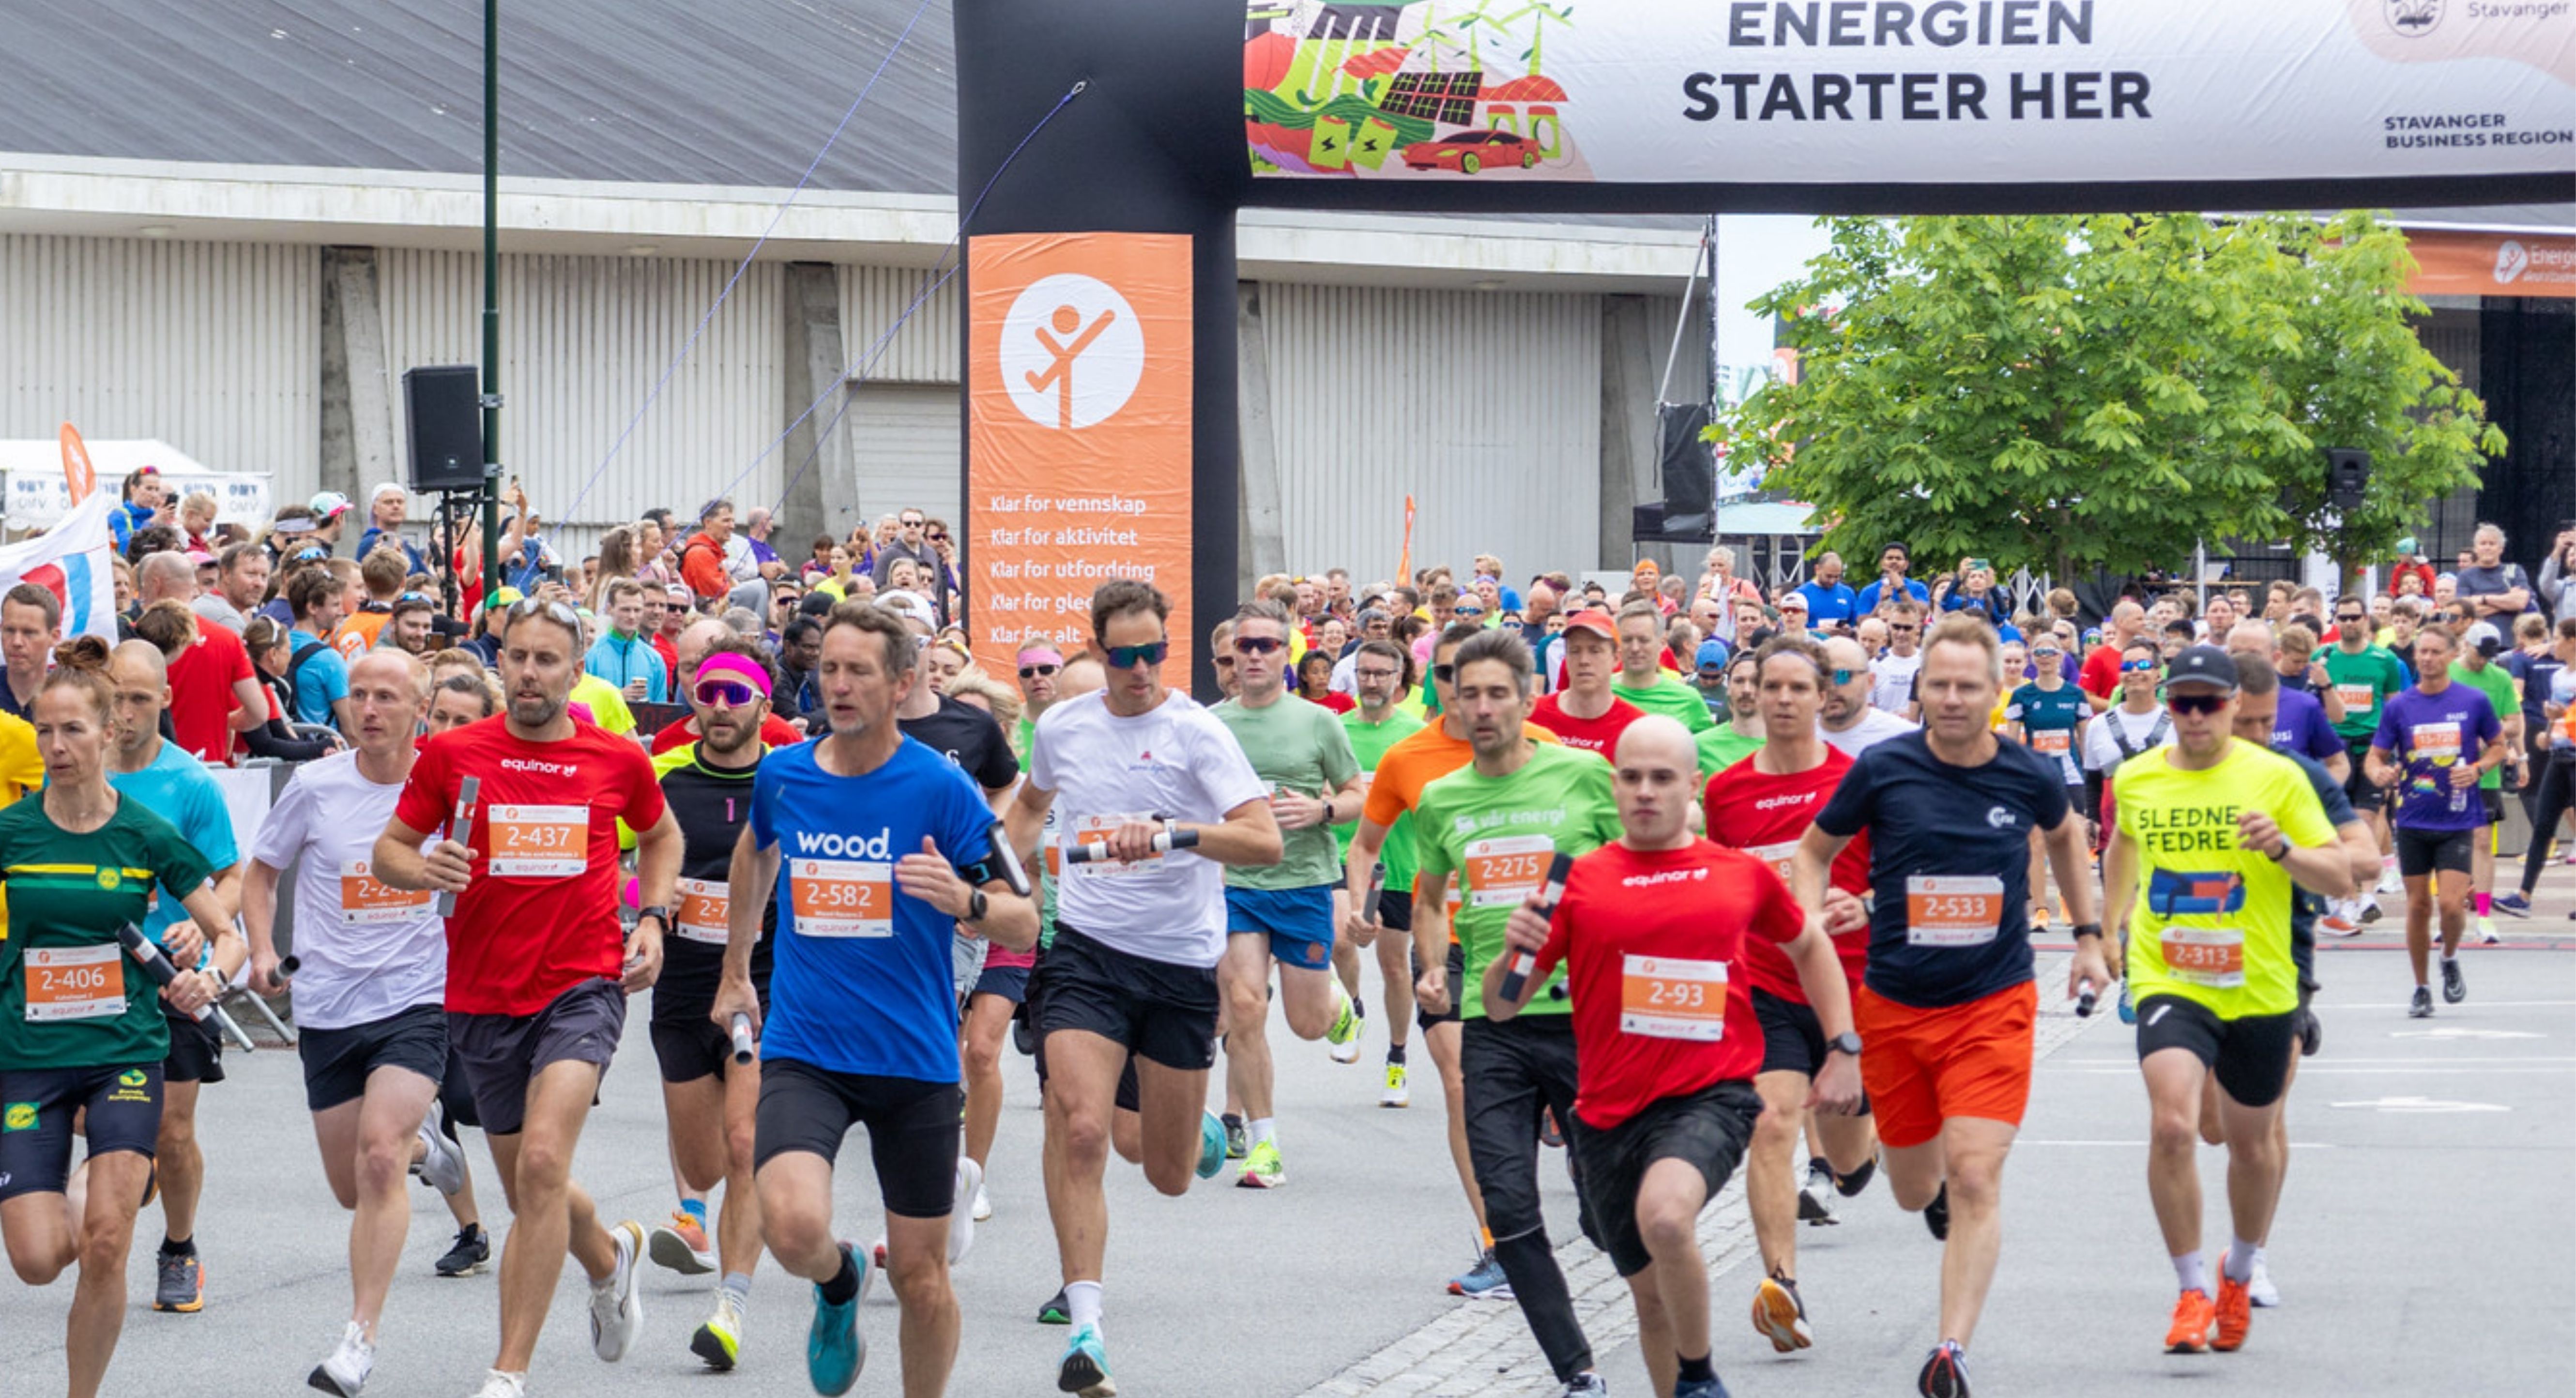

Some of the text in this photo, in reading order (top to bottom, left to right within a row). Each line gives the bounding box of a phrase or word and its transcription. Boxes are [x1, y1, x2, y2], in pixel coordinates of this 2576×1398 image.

[2469, 1, 2568, 19] Stavanger
[1728, 0, 2094, 46] ENERGIEN
[1682, 72, 2152, 122] STARTER HER
[2384, 114, 2506, 130] STAVANGER
[2386, 131, 2574, 148] BUSINESS REGION
[991, 494, 1146, 516] Klar for vennskap
[991, 527, 1138, 546] Klar for aktivitet
[991, 560, 1155, 580] Klar for utfordring
[991, 592, 1094, 615] Klar for gle
[991, 627, 1020, 643] Klar
[1055, 627, 1081, 644] alt
[501, 758, 561, 773] equinor
[726, 798, 735, 822] 1
[1755, 794, 1802, 810] equinor
[1510, 803, 1566, 828] energi
[2139, 805, 2241, 830] SLEDNE
[506, 826, 571, 847] 2-437
[2146, 830, 2232, 852] FEDRE
[1482, 856, 1539, 879] 2-275
[1622, 870, 1690, 887] equinor
[806, 882, 872, 907] 2-582
[699, 899, 729, 918] 2-7
[1924, 897, 1987, 917] 2-533
[2174, 946, 2229, 965] 2-313
[40, 967, 105, 991] 2-406
[1649, 981, 1704, 1007] 2-93
